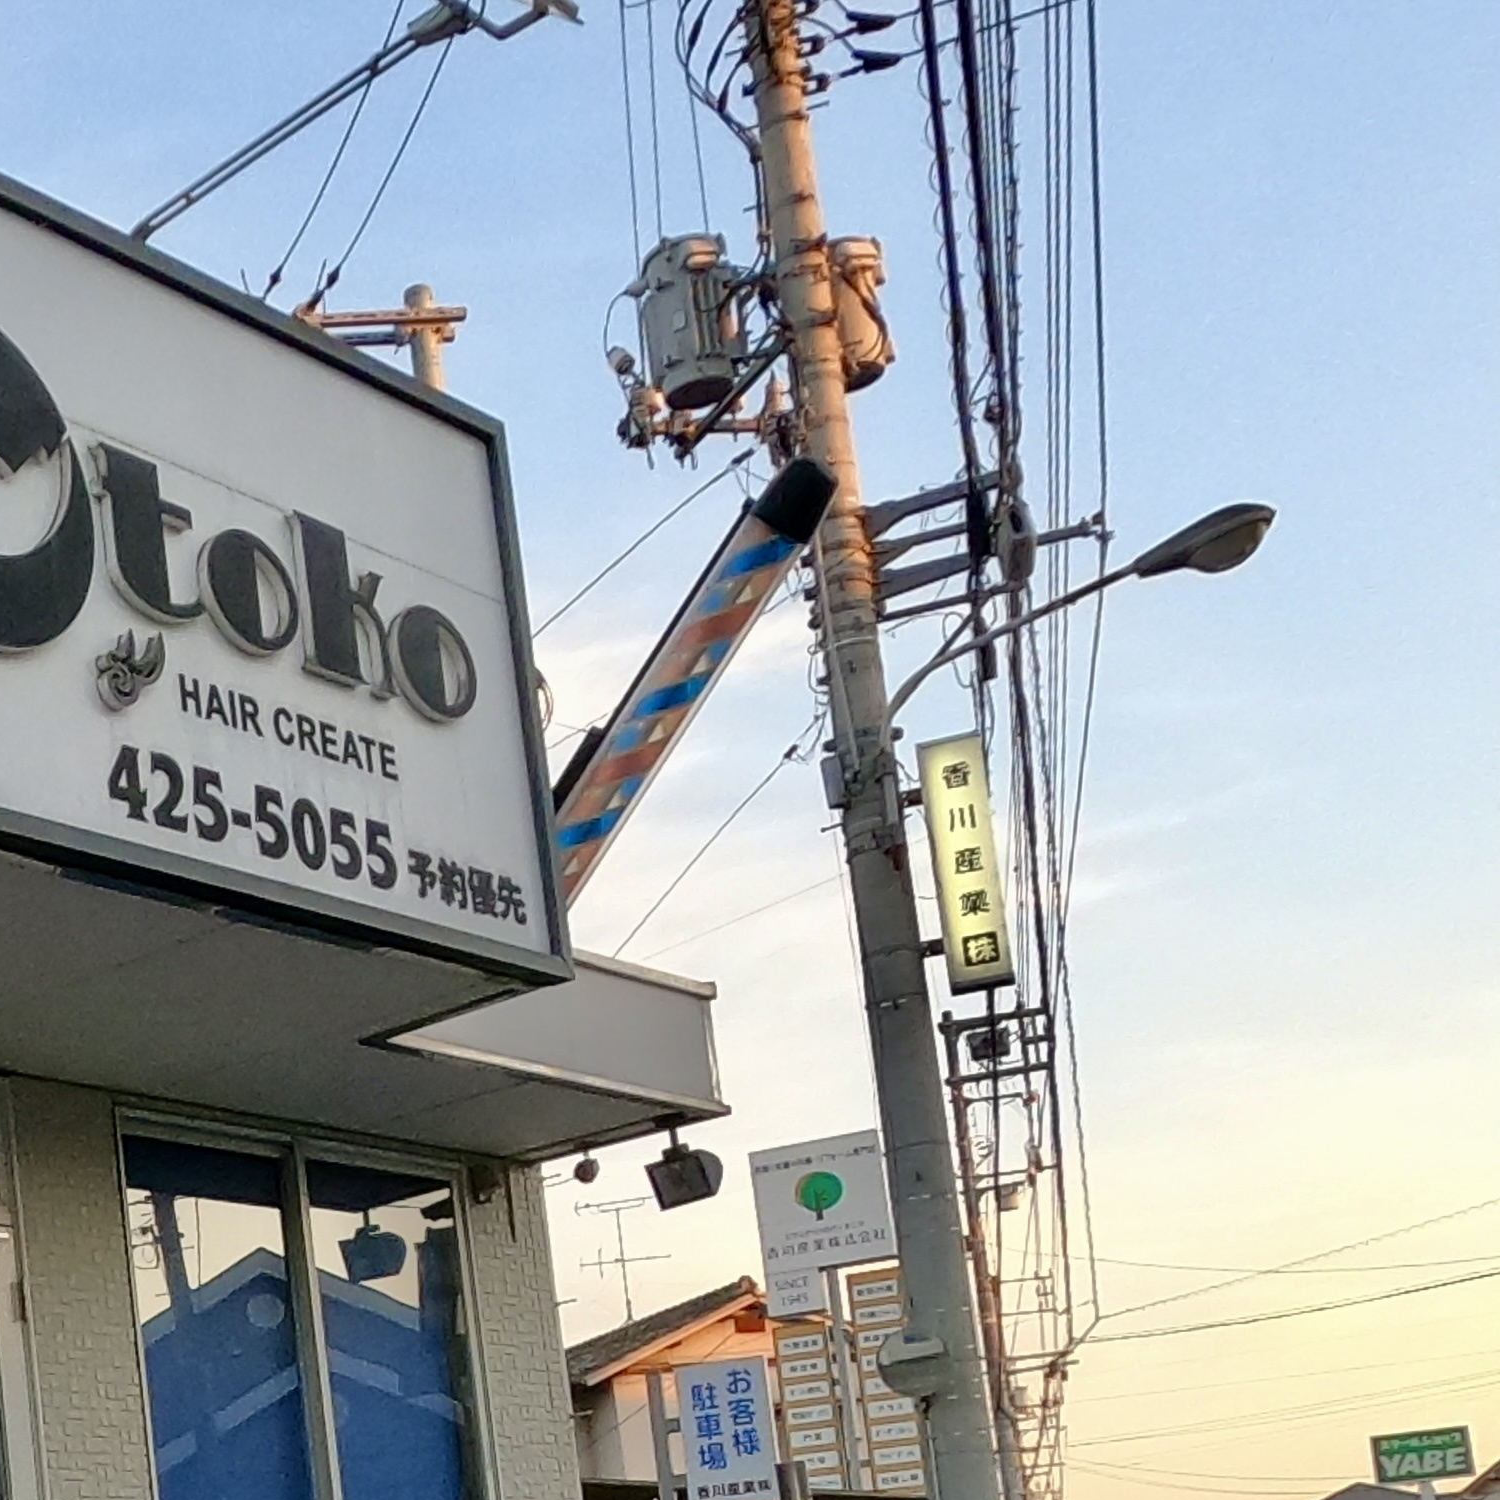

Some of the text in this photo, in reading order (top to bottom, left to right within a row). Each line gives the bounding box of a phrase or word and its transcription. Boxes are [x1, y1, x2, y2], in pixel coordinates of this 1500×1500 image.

[178, 673, 399, 781] HAIR CREATE
[108, 744, 527, 924] 425-5055 予約優先
[691, 1382, 727, 1470] 駐車場
[726, 1369, 760, 1456] お客様
[1378, 1446, 1467, 1478] YABE
